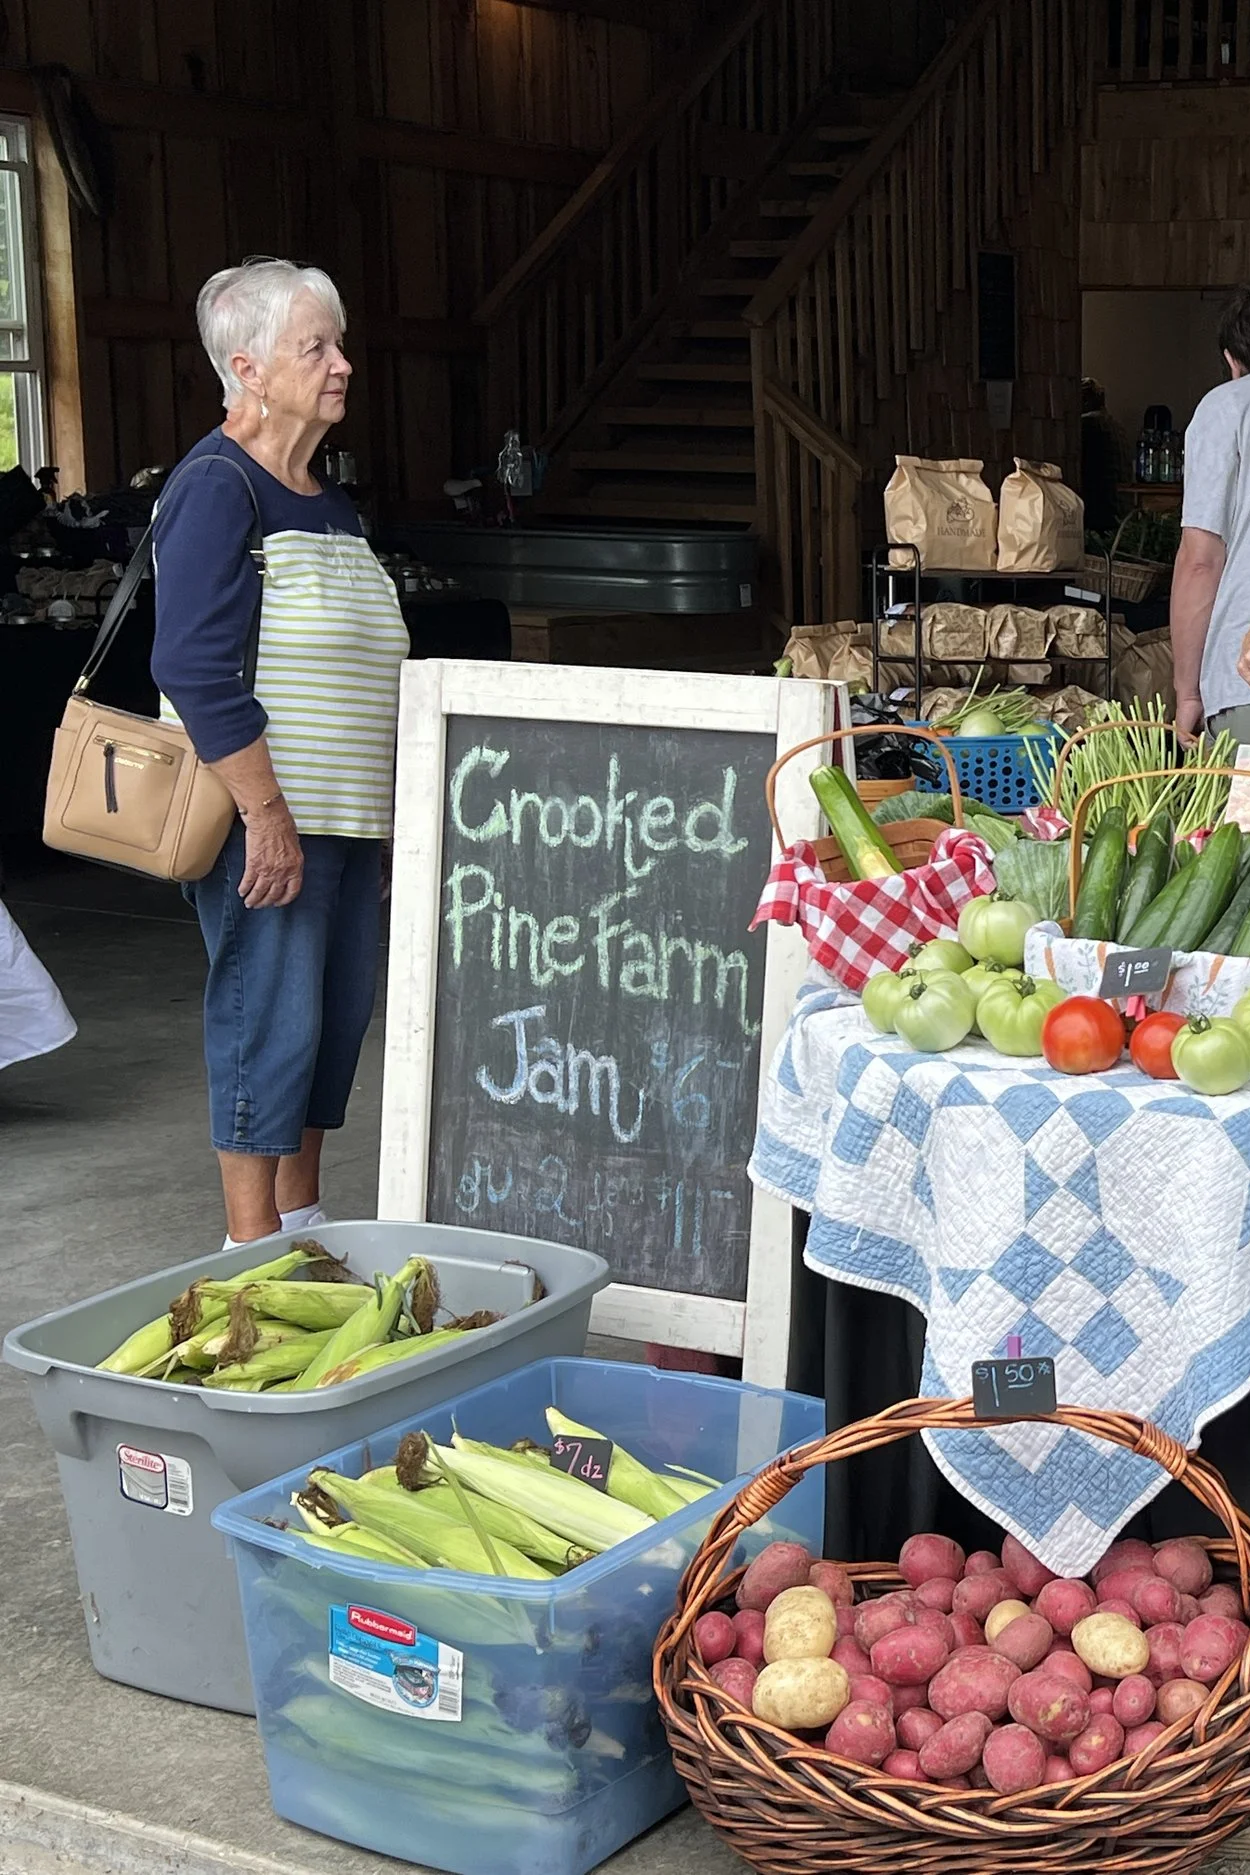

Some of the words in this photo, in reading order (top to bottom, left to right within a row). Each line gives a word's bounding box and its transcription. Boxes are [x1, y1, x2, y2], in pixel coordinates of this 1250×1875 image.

[450, 745, 750, 879] Crooked
[445, 863, 585, 987] Pine
[475, 1004, 646, 1143] Jam
[350, 1610, 414, 1642] Rubbermaid
